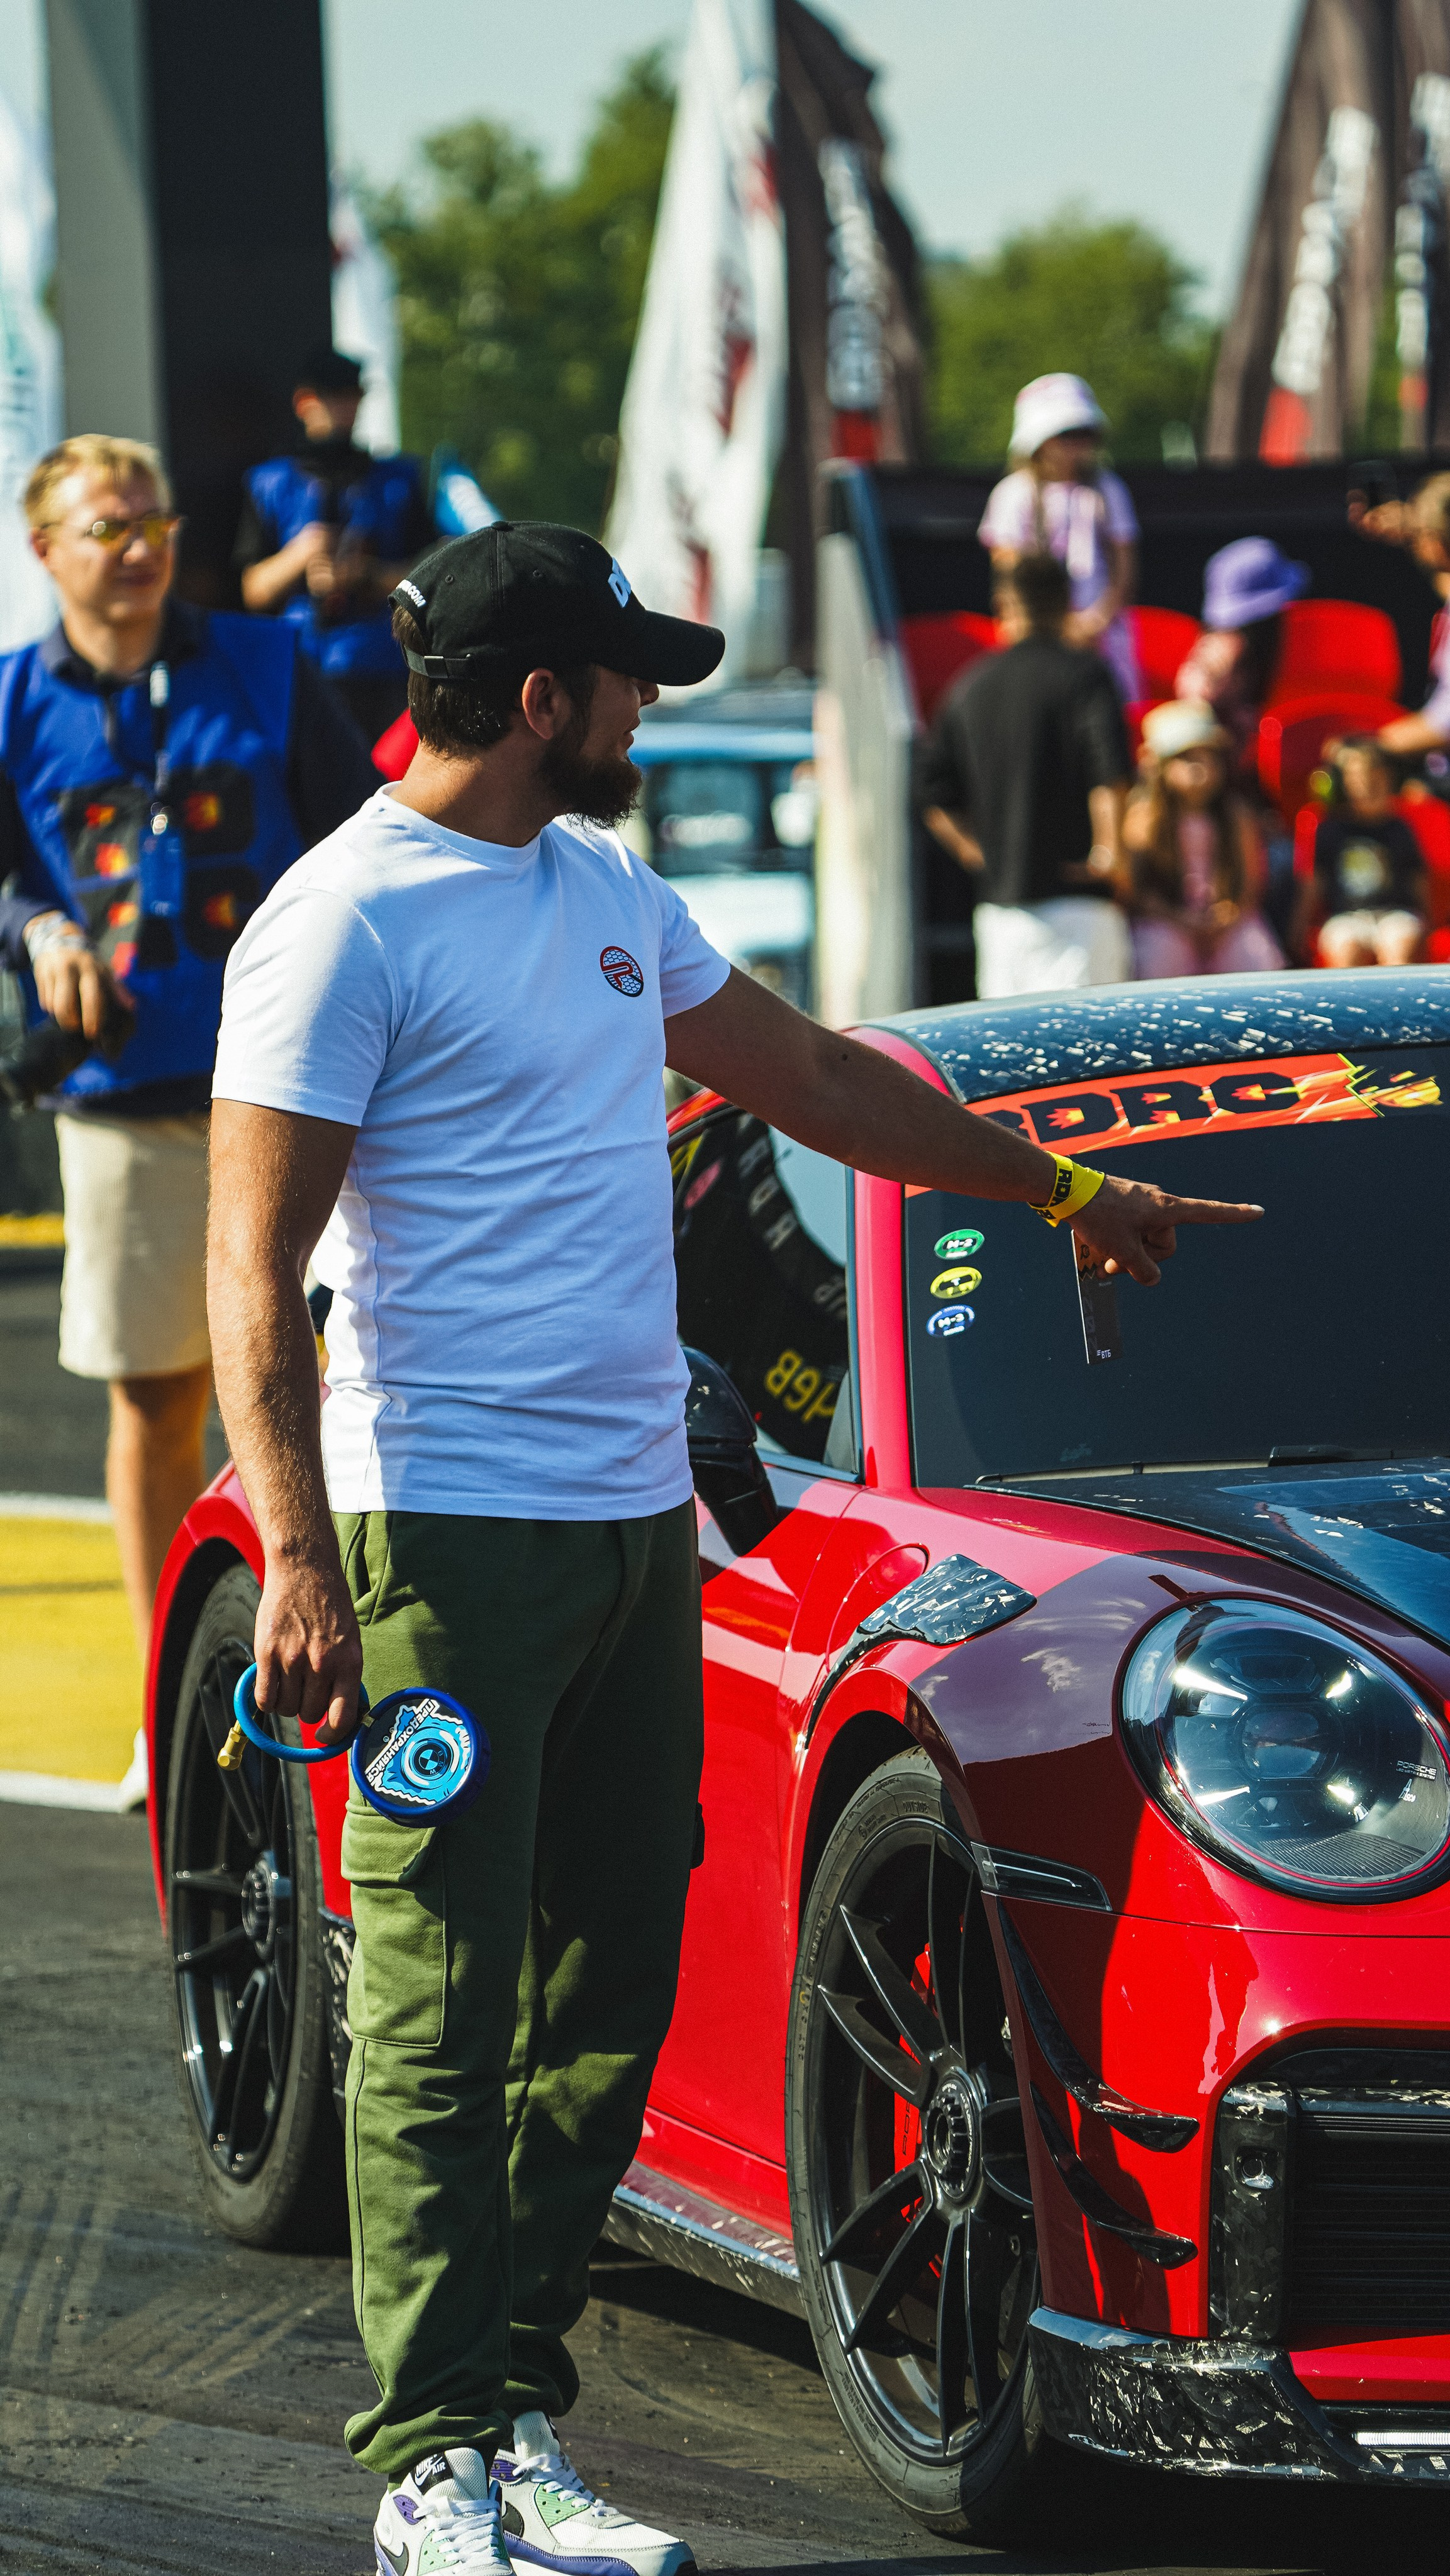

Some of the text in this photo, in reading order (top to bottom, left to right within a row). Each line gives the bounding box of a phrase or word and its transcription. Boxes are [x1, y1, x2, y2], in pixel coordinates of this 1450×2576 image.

[365, 1699, 435, 1782] ПРЕДОХРАНЯЙСЯ
[1397, 1760, 1437, 1776] PORSCHE
[416, 2456, 434, 2477] NIKE
[432, 2462, 446, 2475] AIR
